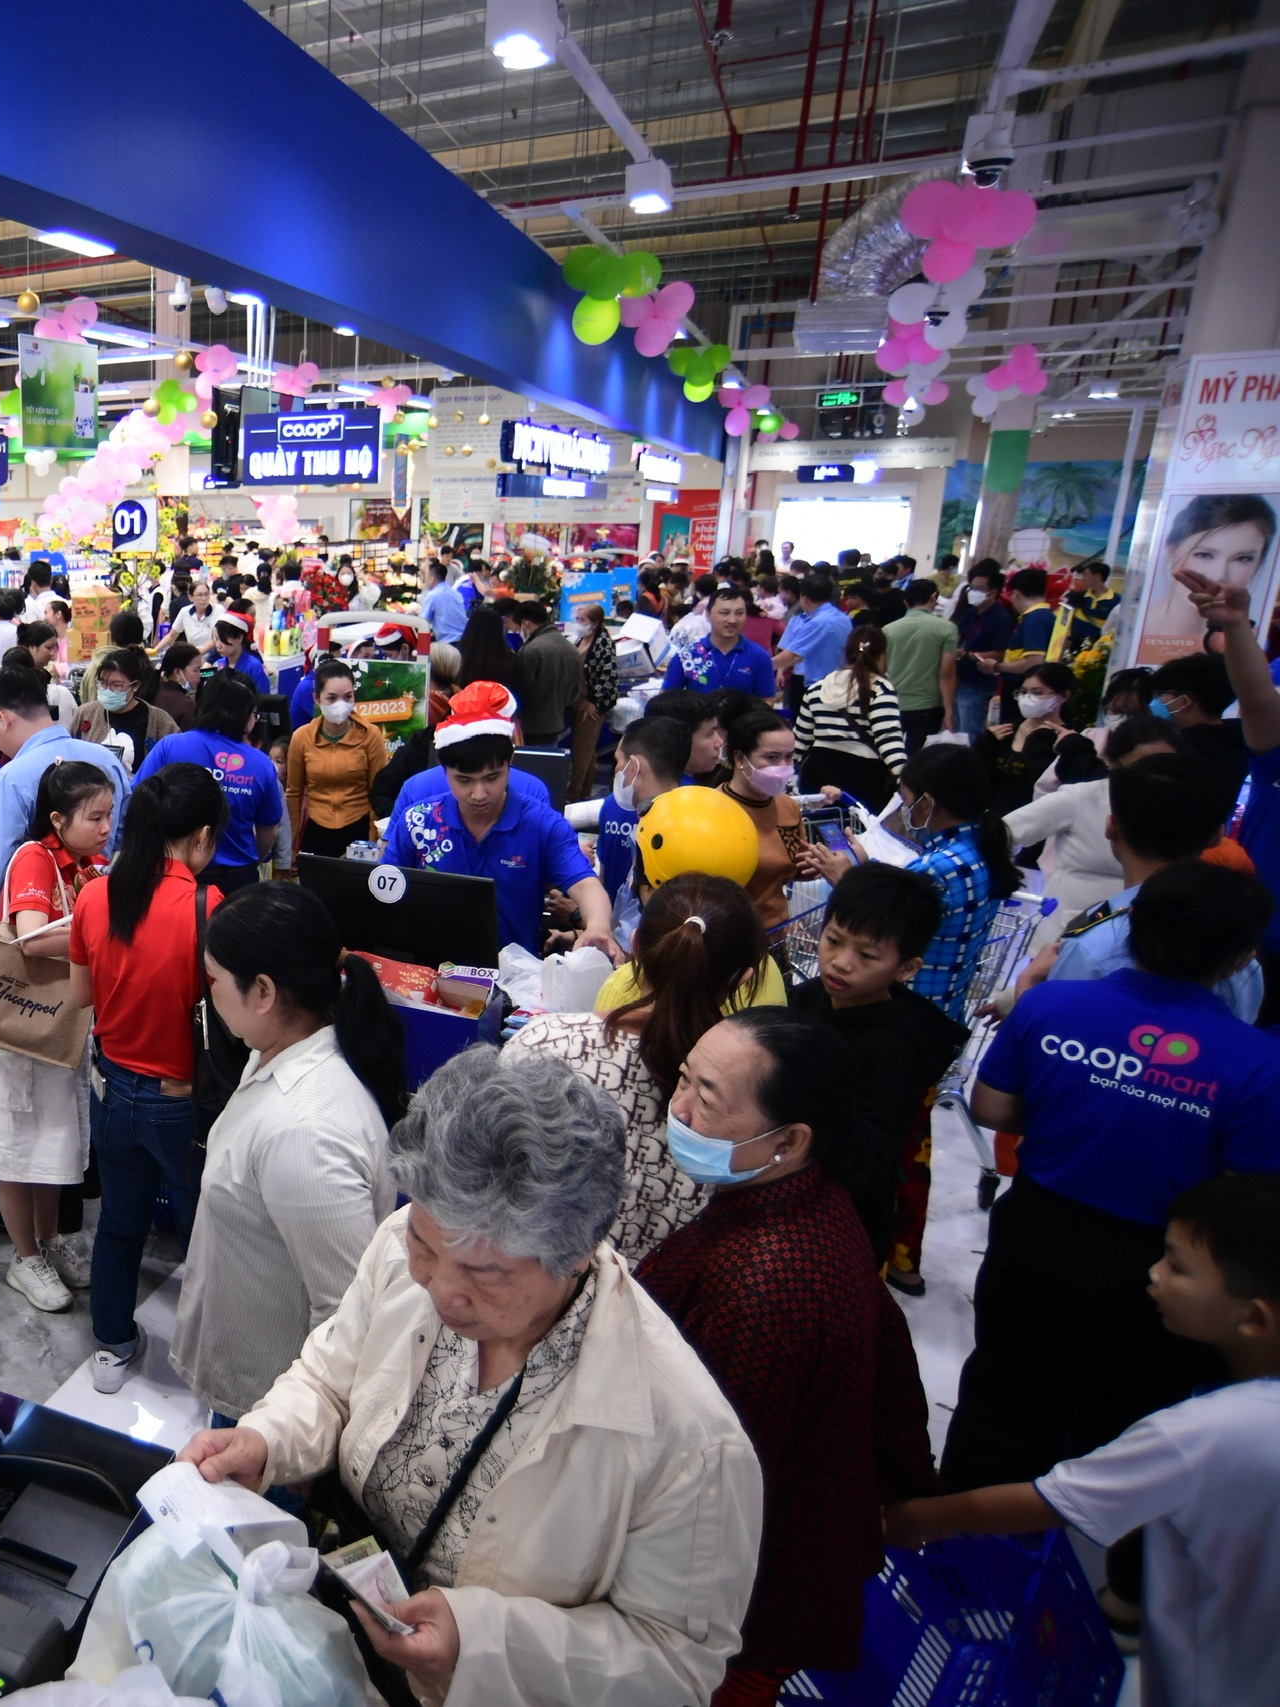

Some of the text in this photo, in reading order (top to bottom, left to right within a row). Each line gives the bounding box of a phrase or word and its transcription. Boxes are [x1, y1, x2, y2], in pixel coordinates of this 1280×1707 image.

[1198, 371, 1238, 404] MỸ
[249, 445, 373, 480] QUẦY THU HỘ
[114, 510, 141, 535] 01
[377, 875, 397, 891] 07
[457, 968, 494, 978] URBOX
[1089, 1072, 1211, 1120] bạn của mọi nhà
